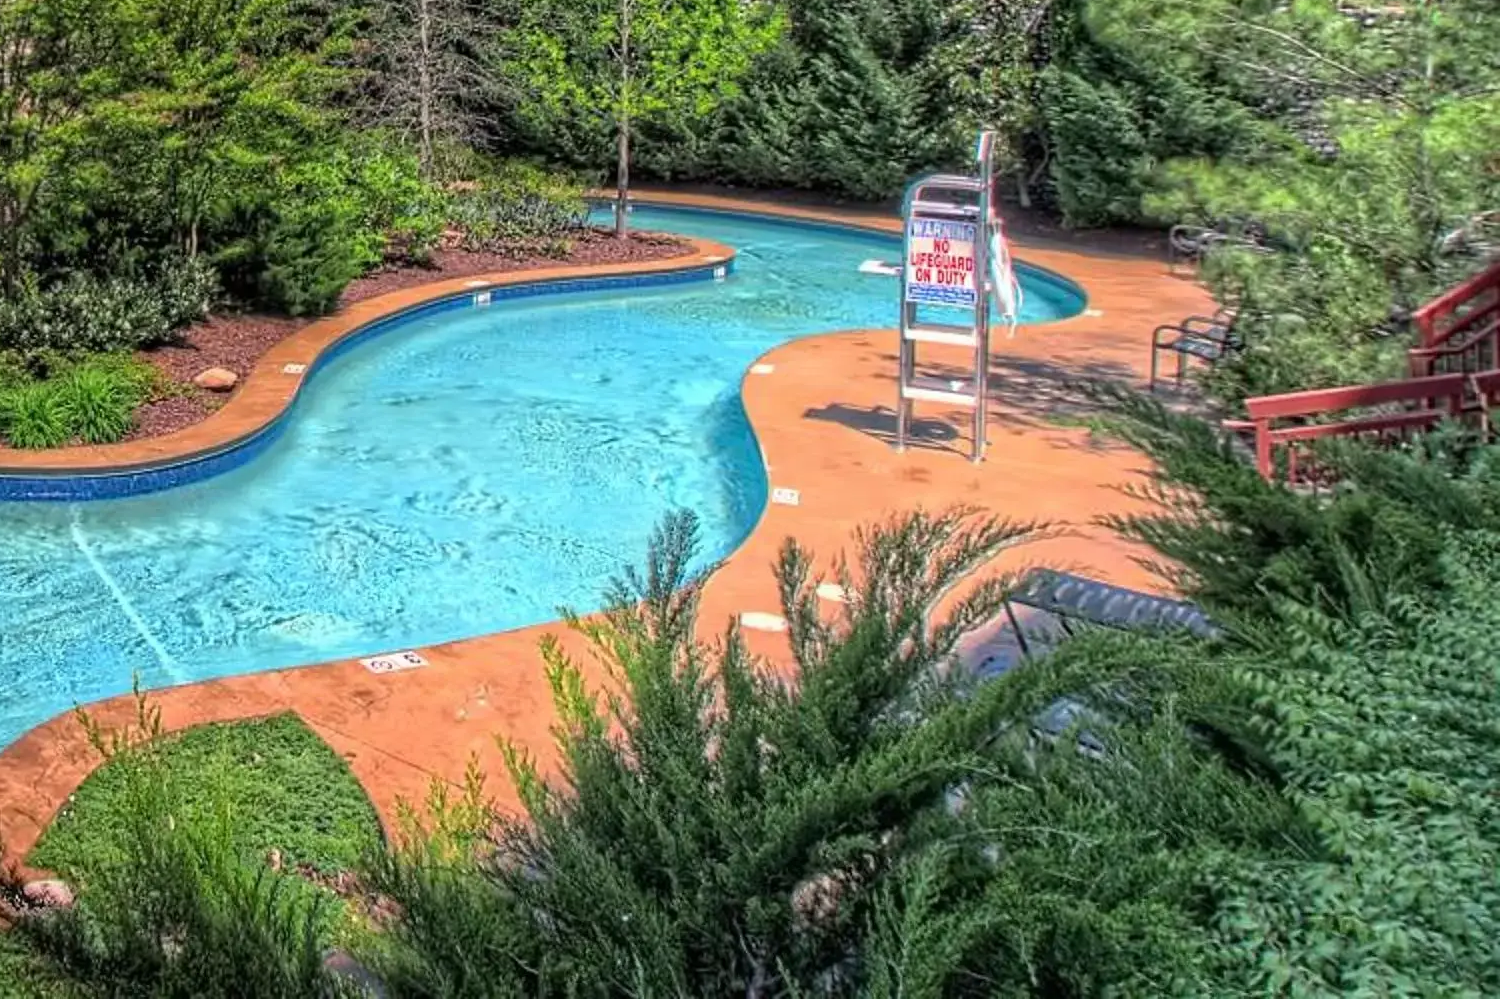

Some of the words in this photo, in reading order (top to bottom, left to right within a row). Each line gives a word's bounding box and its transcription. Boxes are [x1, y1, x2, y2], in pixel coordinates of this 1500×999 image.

[911, 221, 976, 240] WARNING
[933, 238, 950, 253] NO
[910, 252, 974, 271] LIFEGUARD
[915, 268, 931, 282] ON
[937, 270, 967, 285] DUTY
